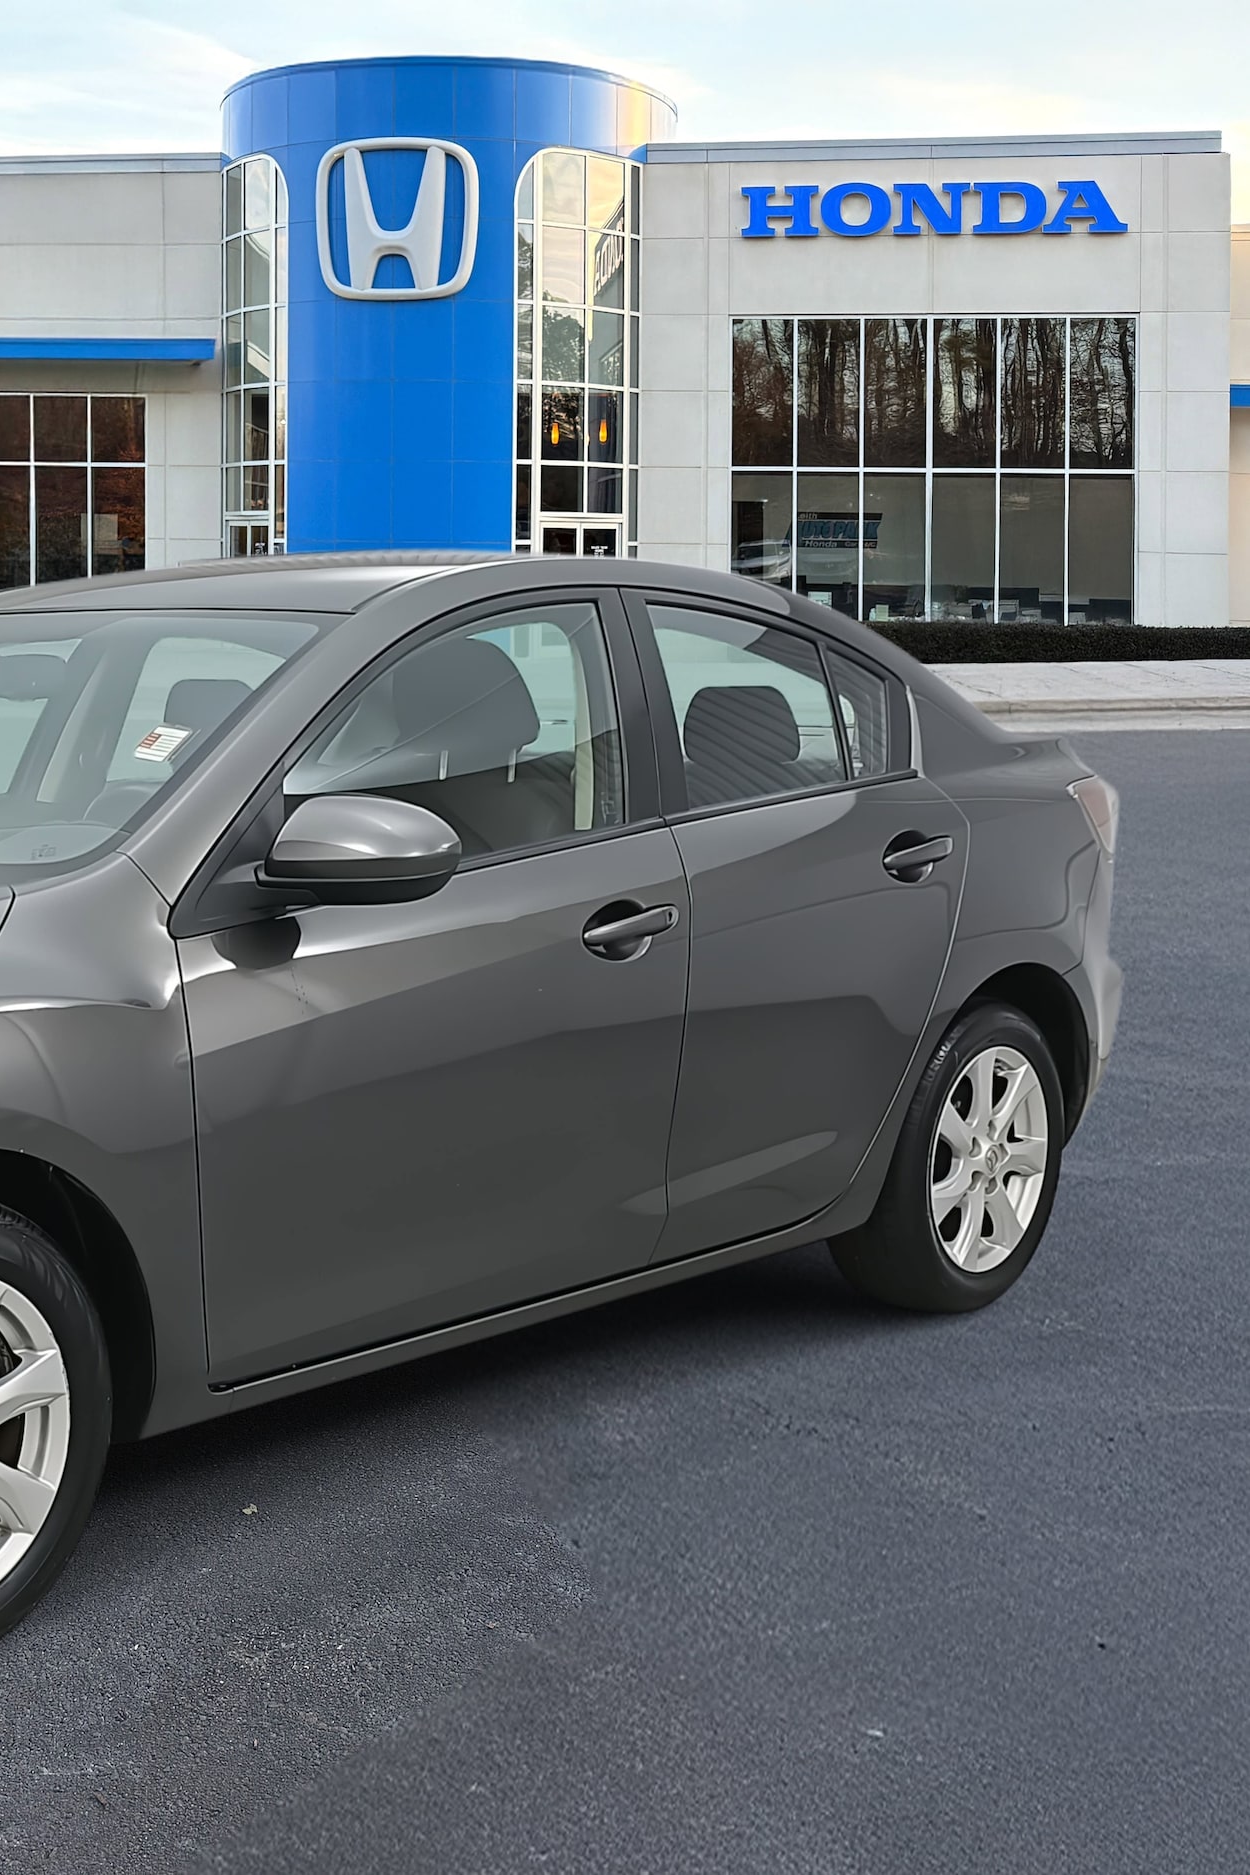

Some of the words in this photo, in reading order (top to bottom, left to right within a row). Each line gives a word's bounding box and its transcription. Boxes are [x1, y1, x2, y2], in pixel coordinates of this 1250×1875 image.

[741, 181, 1129, 238] HONDA
[797, 512, 818, 520] eith
[784, 520, 880, 539] AUTOPAK
[804, 540, 838, 548] Honda
